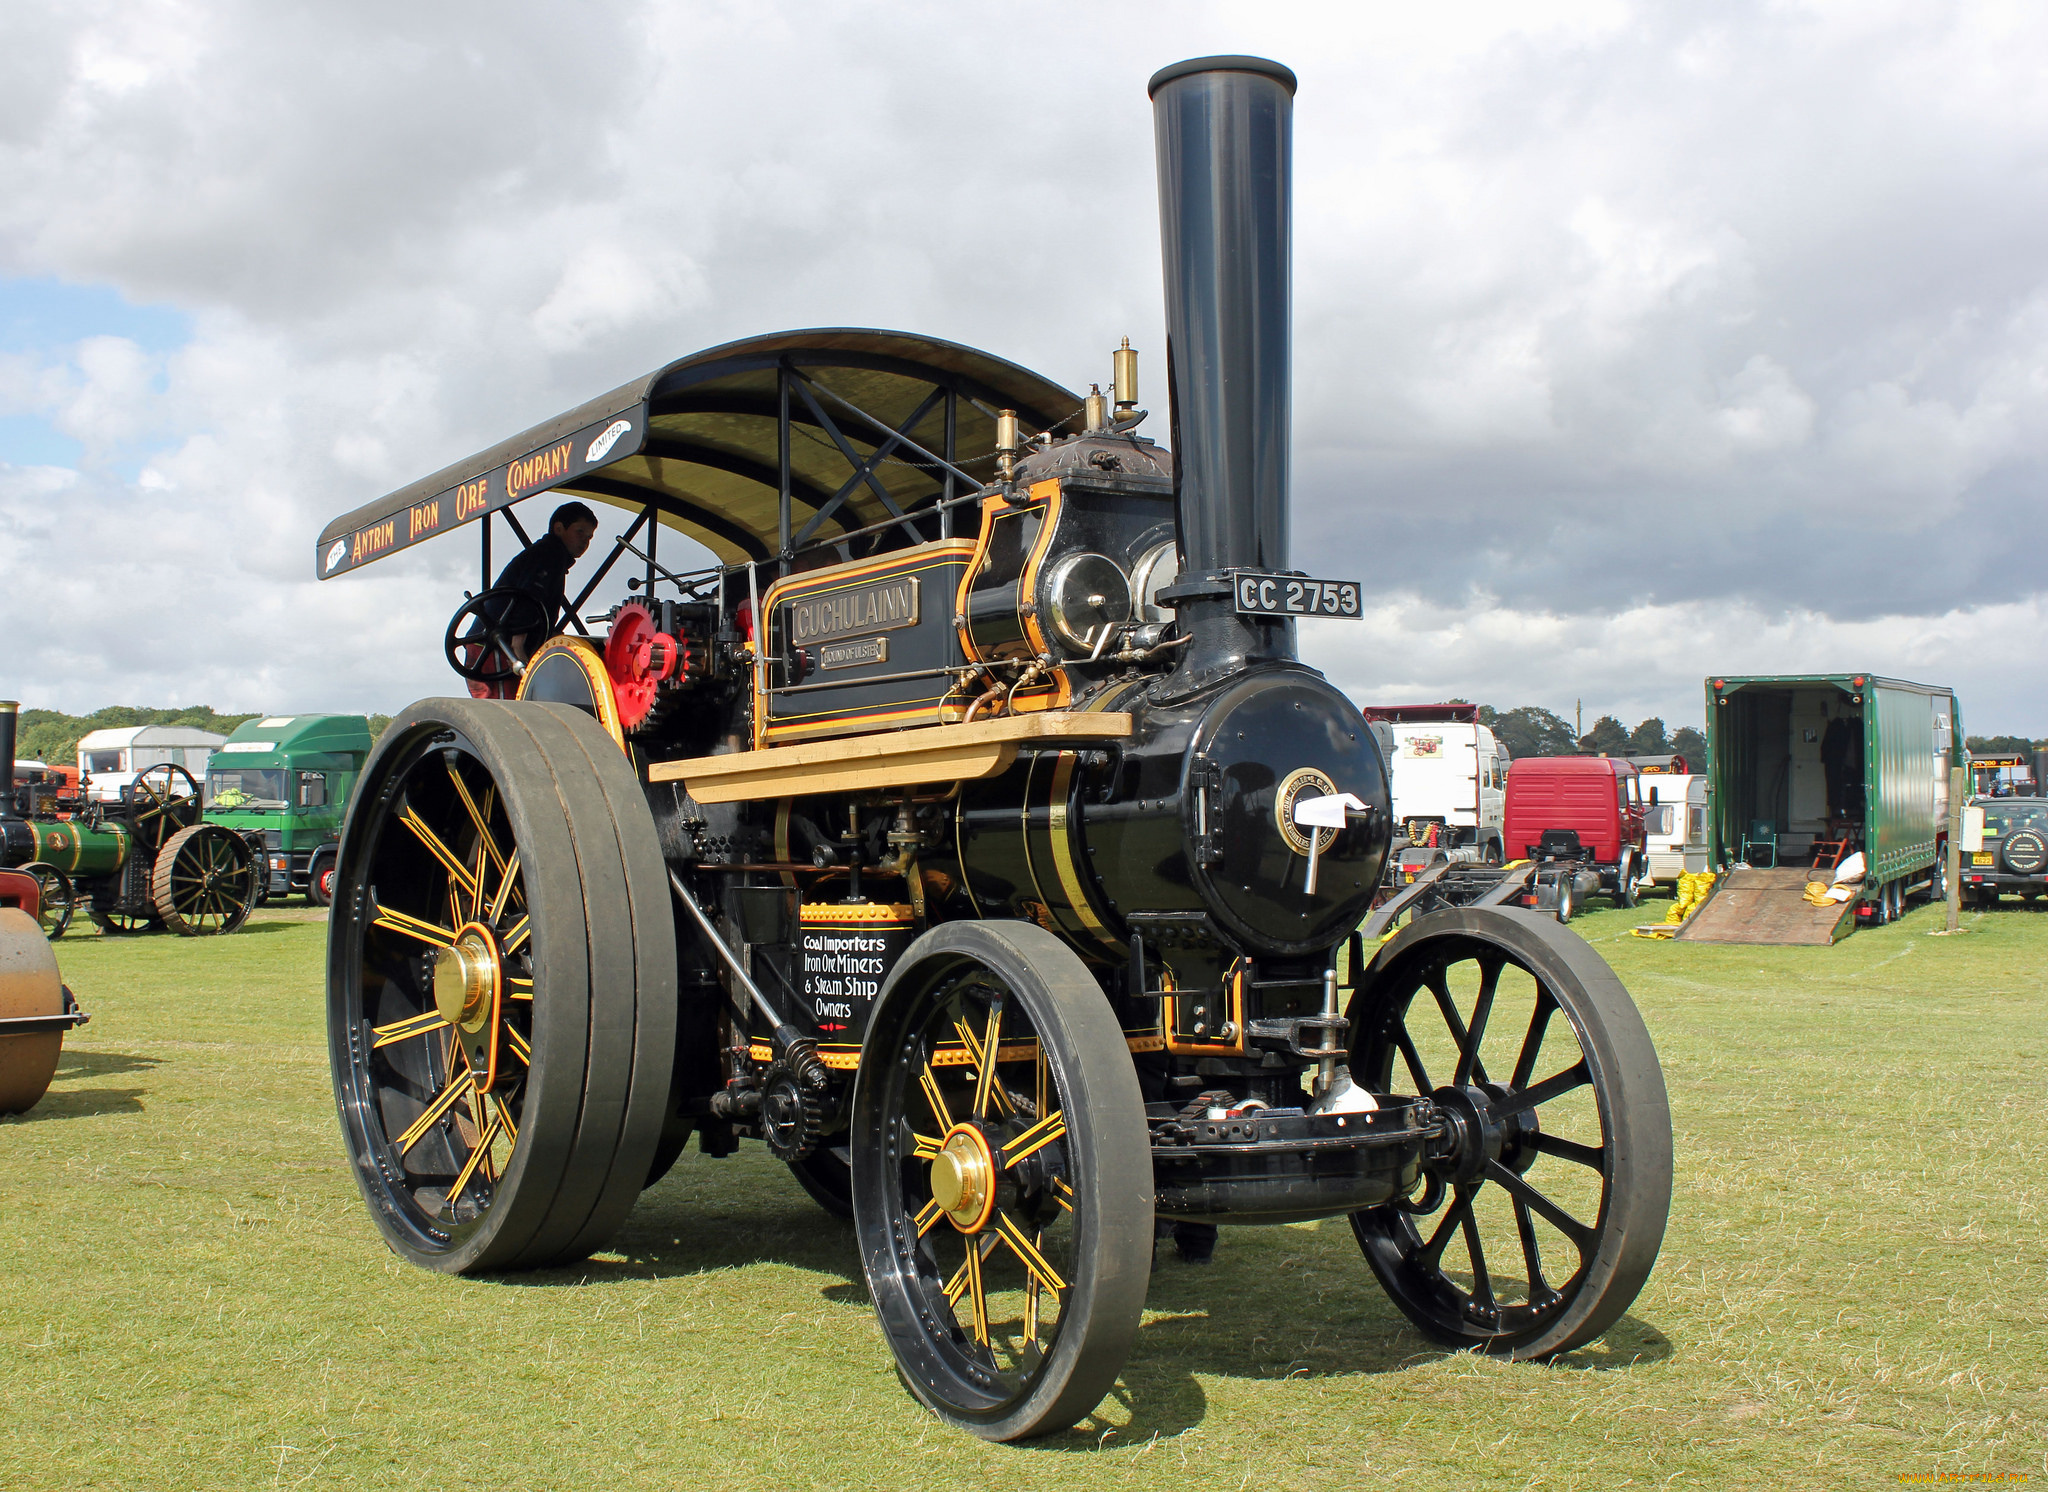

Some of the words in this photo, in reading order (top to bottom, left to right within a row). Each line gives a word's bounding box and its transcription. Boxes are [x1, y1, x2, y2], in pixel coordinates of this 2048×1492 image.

[329, 544, 343, 565] THE
[352, 521, 394, 565] ANTRIM
[409, 501, 439, 540] IRON
[455, 479, 488, 522] ORE
[506, 441, 573, 499] COMPANY
[591, 423, 622, 457] LIMITED
[1240, 578, 1277, 610] CC
[1286, 581, 1358, 615] 2753
[798, 584, 910, 639] CUCHULAINN
[824, 649, 846, 663] HOUND
[846, 647, 855, 660] OF
[855, 644, 879, 659] ULSTER
[803, 935, 823, 951] Coal
[824, 936, 886, 954] Importers
[804, 953, 821, 972] Iron
[822, 954, 836, 973] Ore
[837, 954, 884, 974] Miners
[804, 979, 811, 994] &
[814, 975, 842, 996] Steam
[844, 976, 878, 1000] Ship
[815, 998, 852, 1018] Owners
